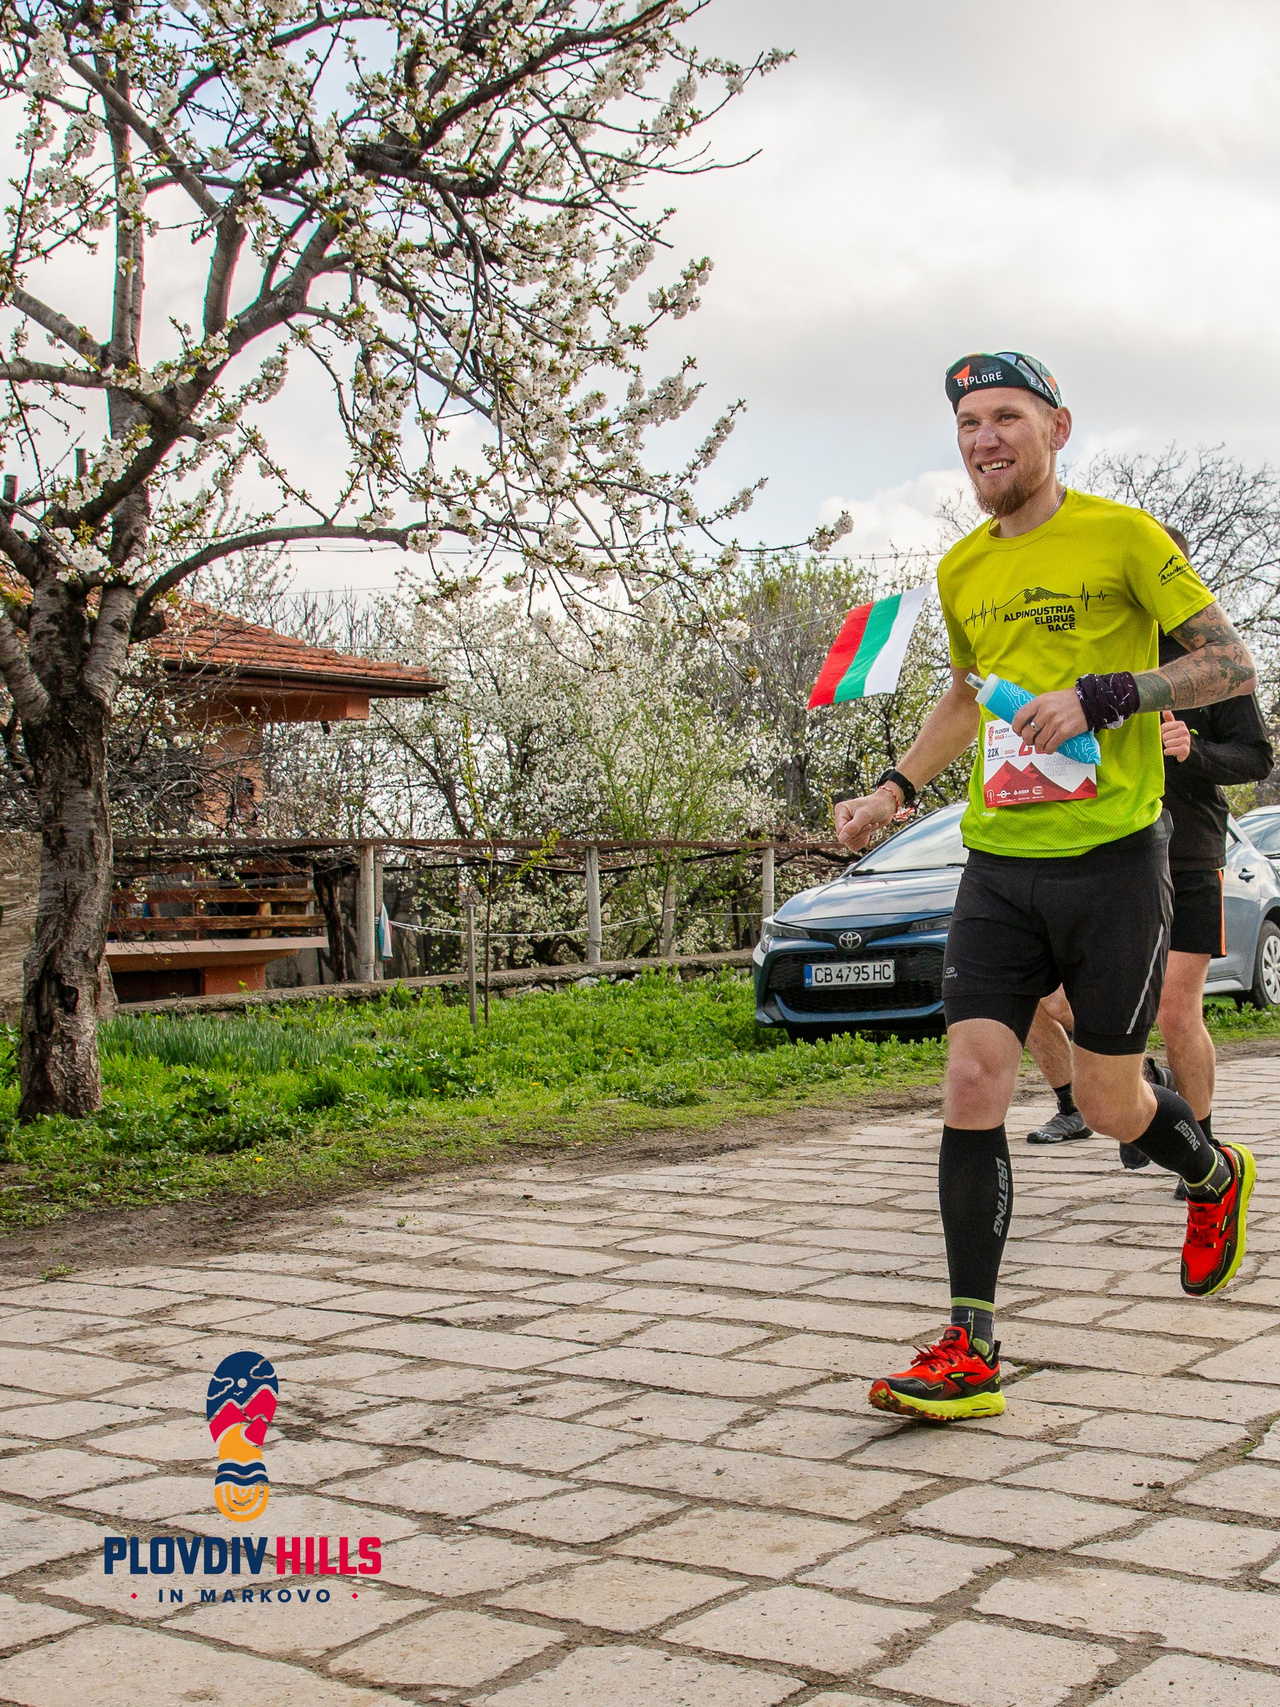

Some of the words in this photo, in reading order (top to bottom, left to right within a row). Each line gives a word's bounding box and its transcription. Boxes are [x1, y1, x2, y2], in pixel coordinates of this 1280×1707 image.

[957, 371, 1003, 387] EXPLORE
[1004, 605, 1075, 622] ALPINDUSTRIA
[1034, 614, 1076, 625] ELBRUS
[1047, 622, 1076, 632] RACE
[987, 747, 999, 758] 22K
[815, 967, 833, 983] CB
[836, 965, 870, 982] 4795
[873, 964, 891, 981] HC
